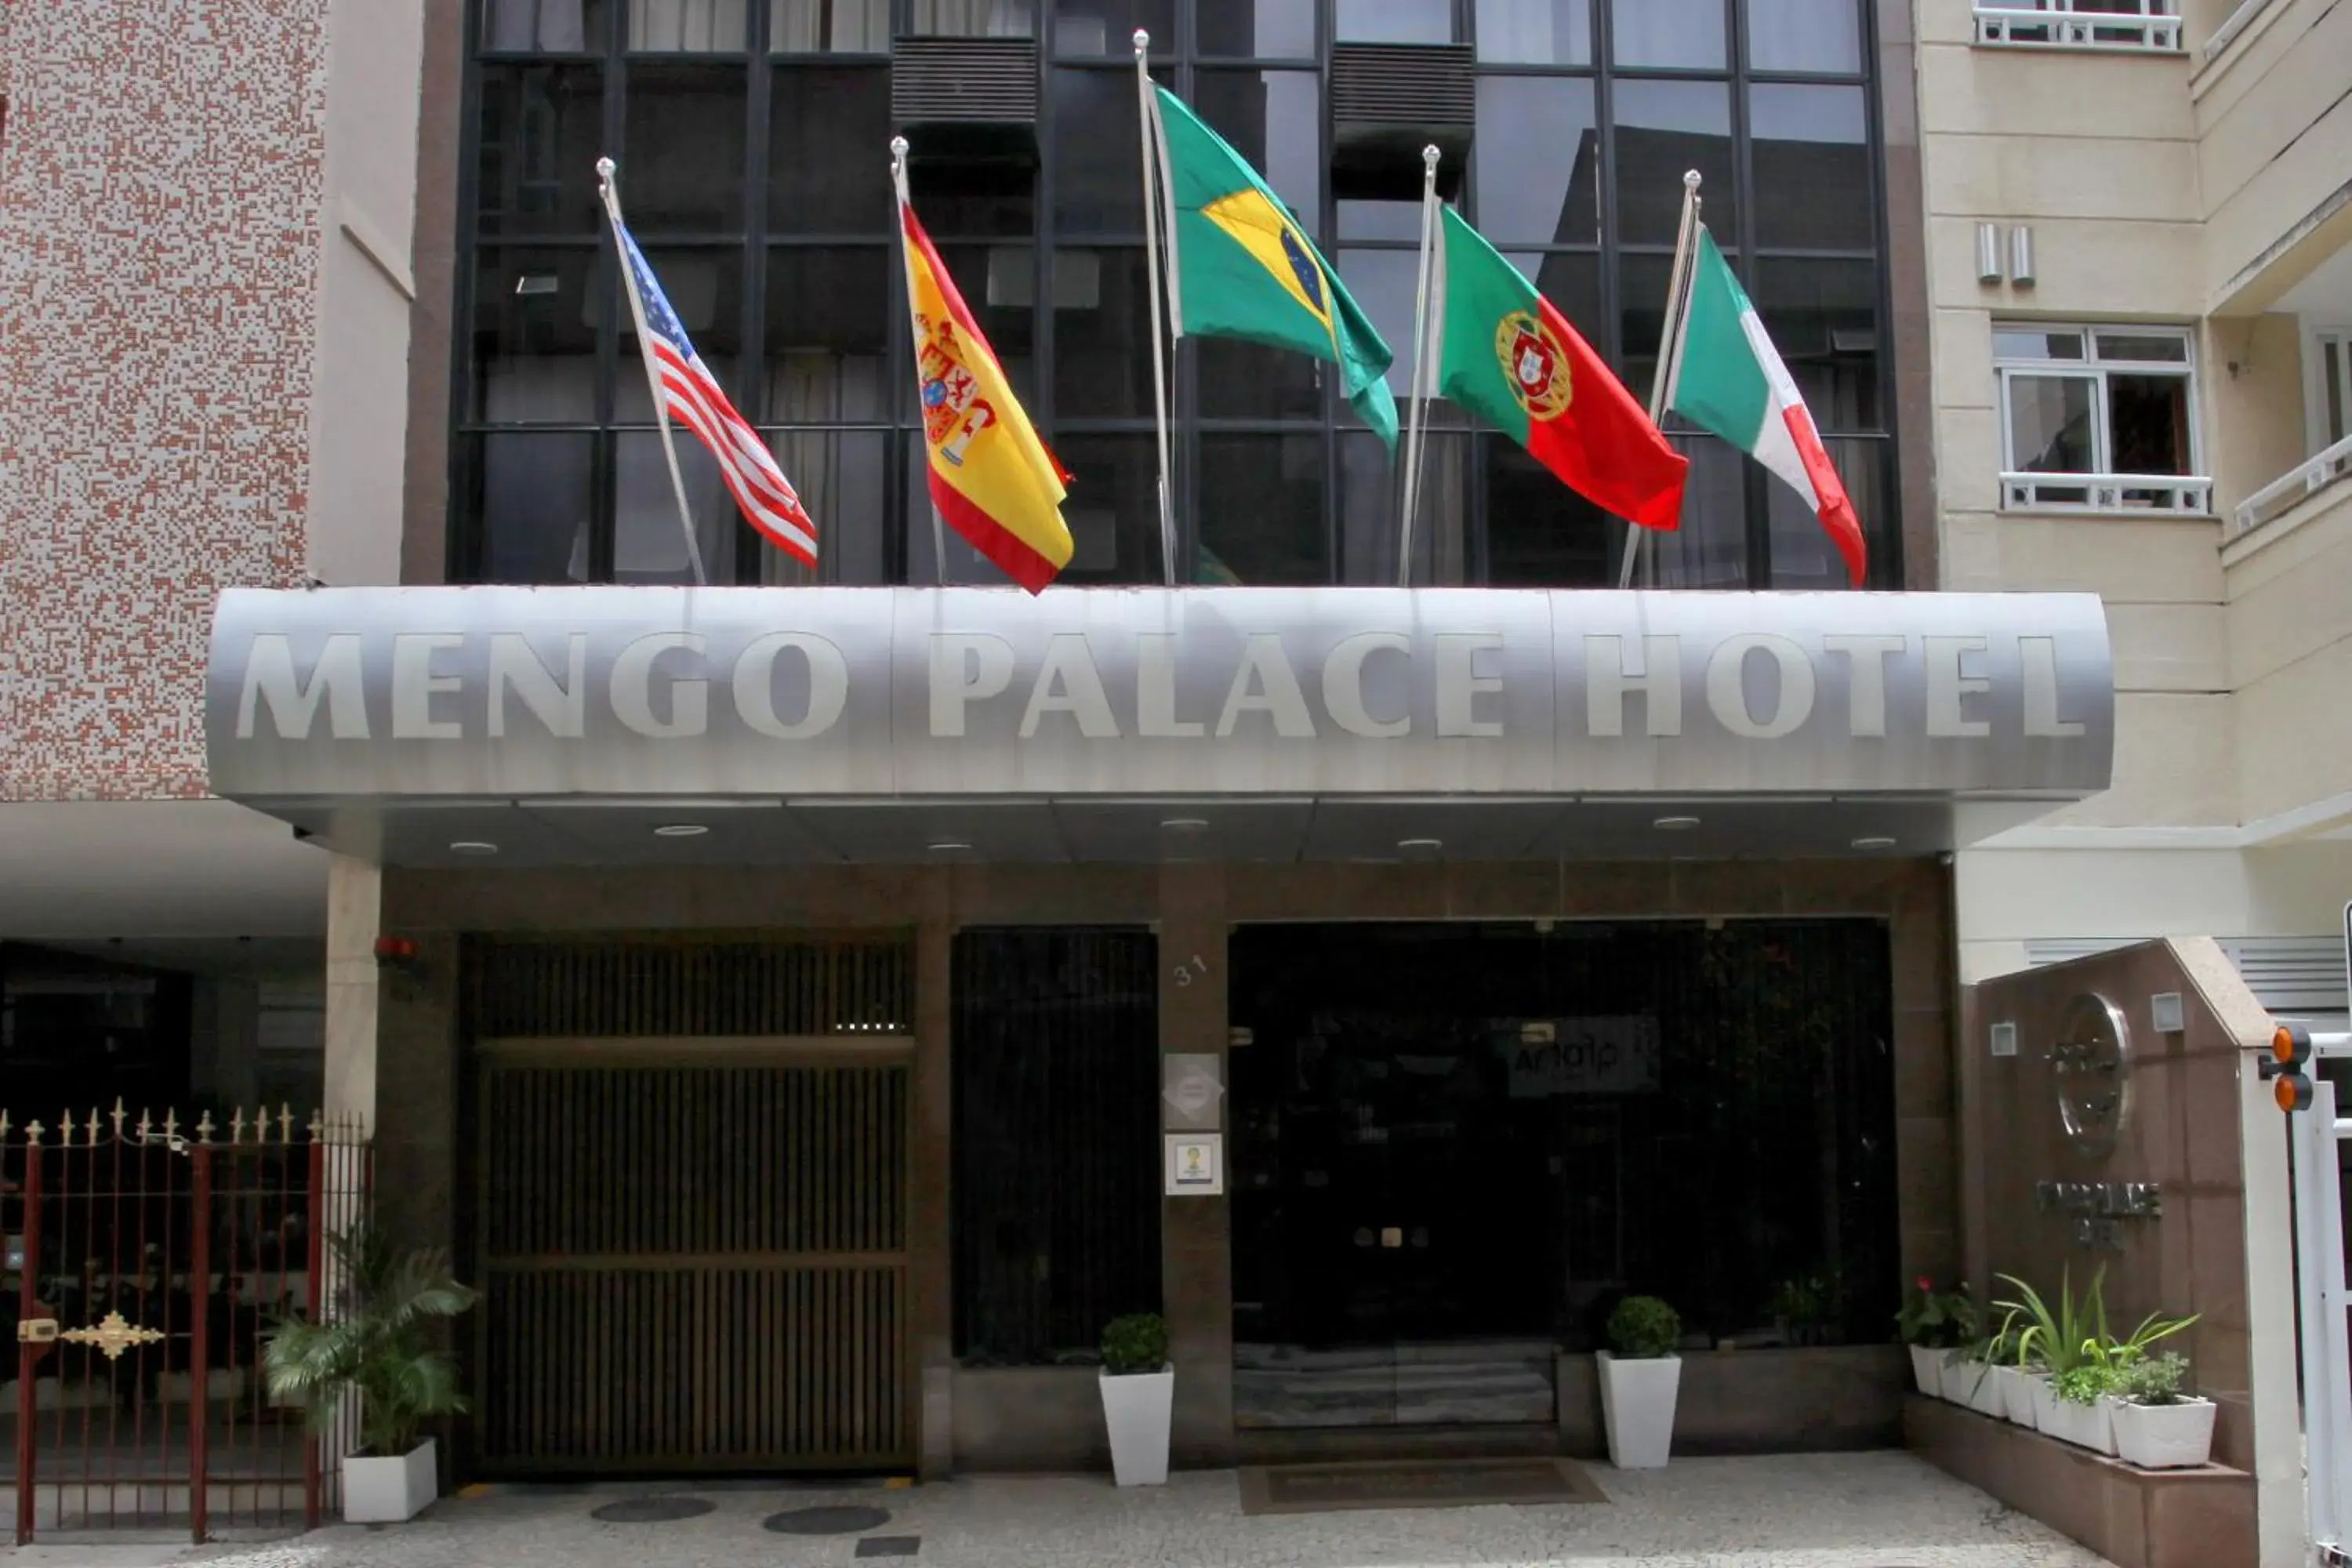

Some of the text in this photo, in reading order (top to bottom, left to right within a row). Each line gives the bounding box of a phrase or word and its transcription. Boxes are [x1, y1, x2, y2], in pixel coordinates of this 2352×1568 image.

[236, 630, 2085, 739] MENGO PALACE HOTEL
[1174, 954, 1207, 986] 31
